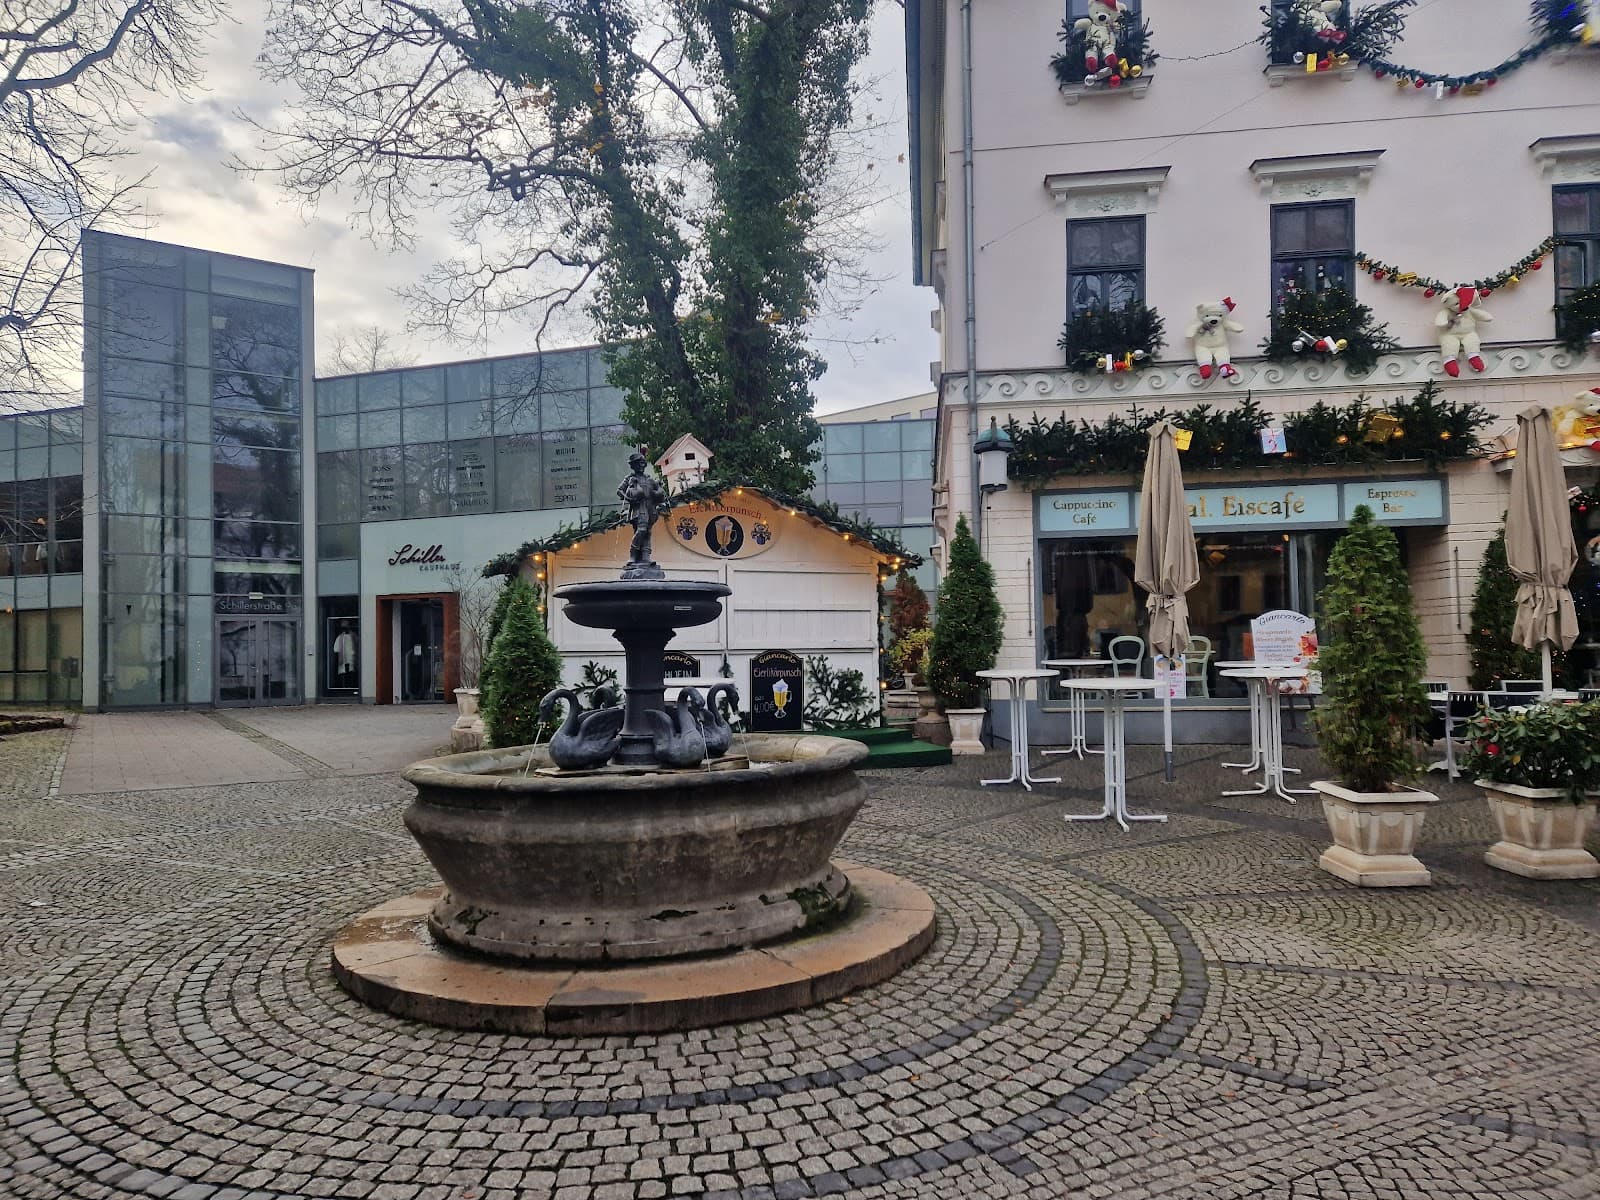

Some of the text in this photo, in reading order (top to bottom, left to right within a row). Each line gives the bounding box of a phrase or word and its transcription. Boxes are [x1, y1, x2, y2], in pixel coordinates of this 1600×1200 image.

[1367, 488, 1416, 501] Espresso
[1053, 498, 1116, 512] Cappuccino
[1222, 491, 1305, 519] Eiscafé
[1383, 502, 1404, 513] Bar
[1072, 512, 1097, 525] Café
[388, 544, 446, 566] Schiller
[758, 651, 797, 664] Giancarlo
